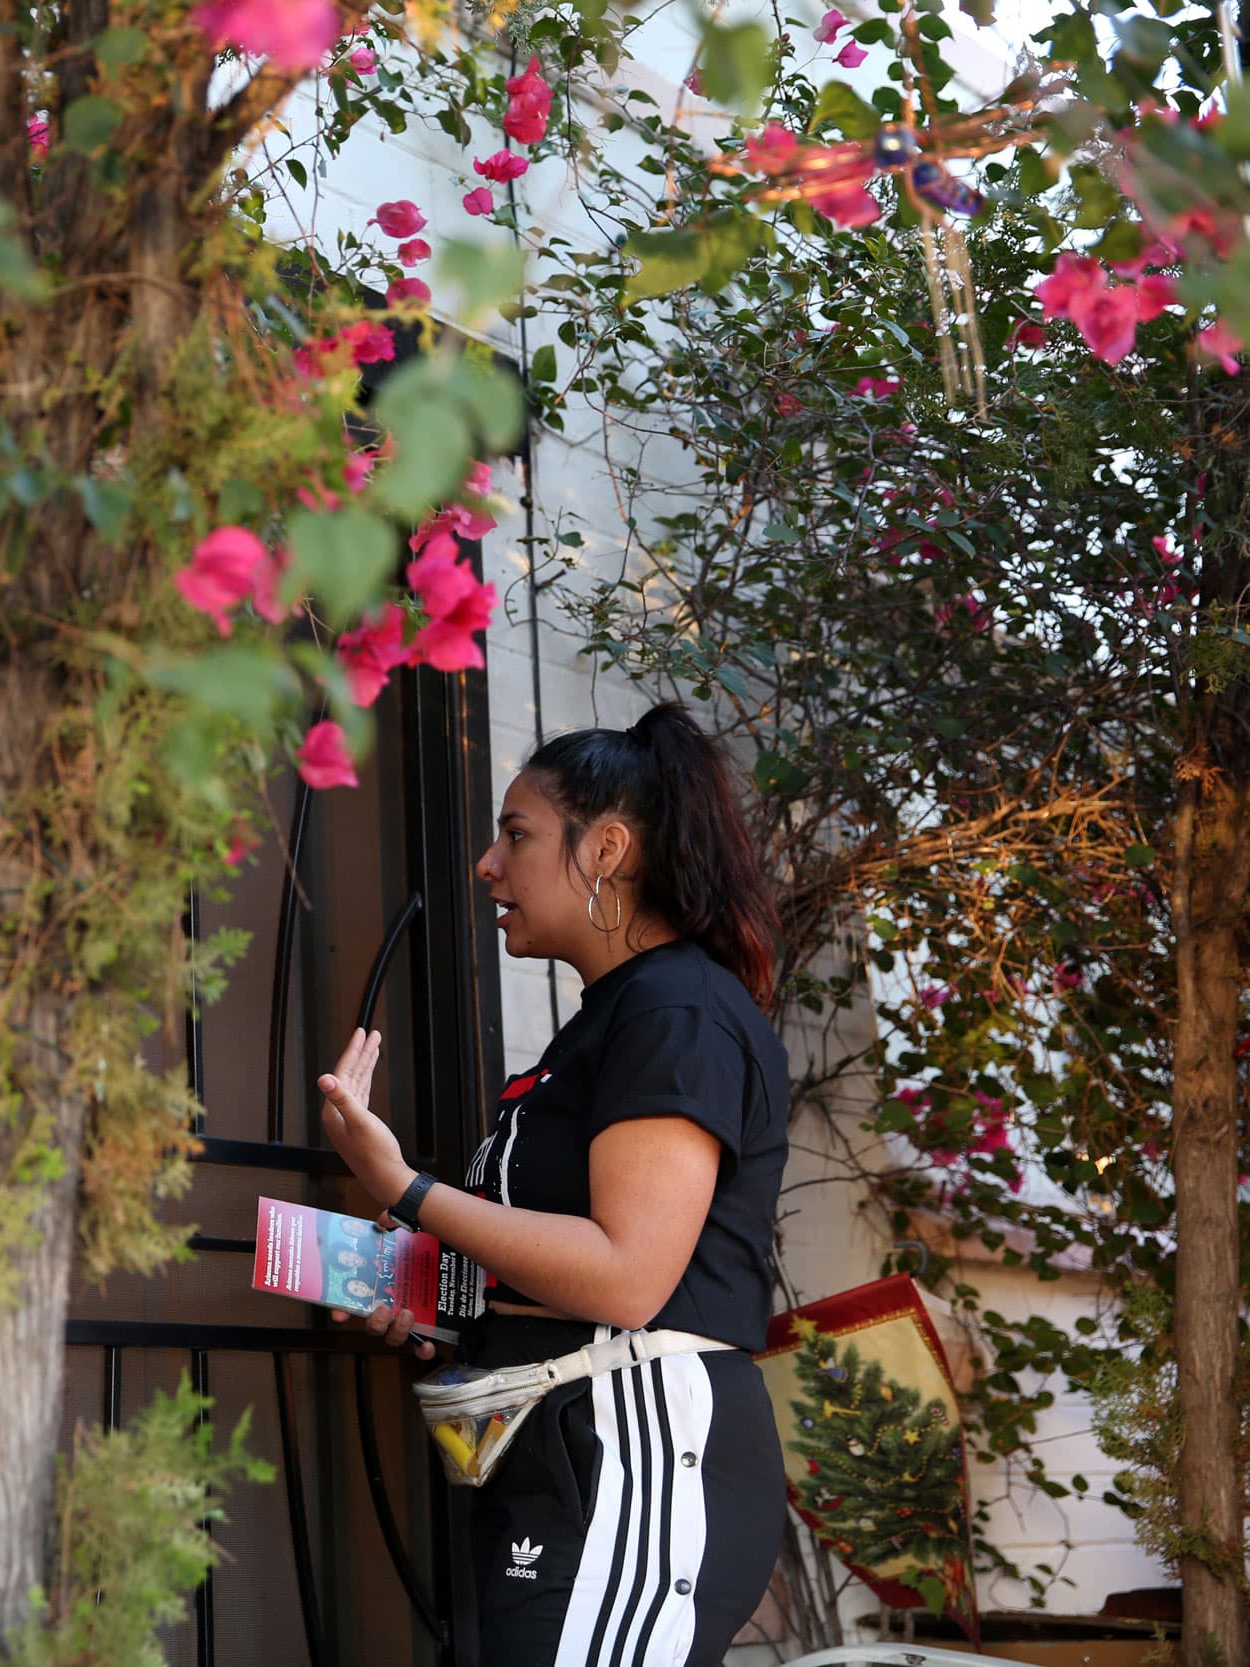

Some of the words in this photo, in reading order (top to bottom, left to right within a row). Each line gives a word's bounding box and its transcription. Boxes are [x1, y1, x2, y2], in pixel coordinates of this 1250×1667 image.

[439, 1252, 451, 1272] Day
[448, 1257, 457, 1288] November
[438, 1273, 449, 1312] Election
[447, 1289, 457, 1316] Tuesday,
[505, 1566, 537, 1580] adidas
